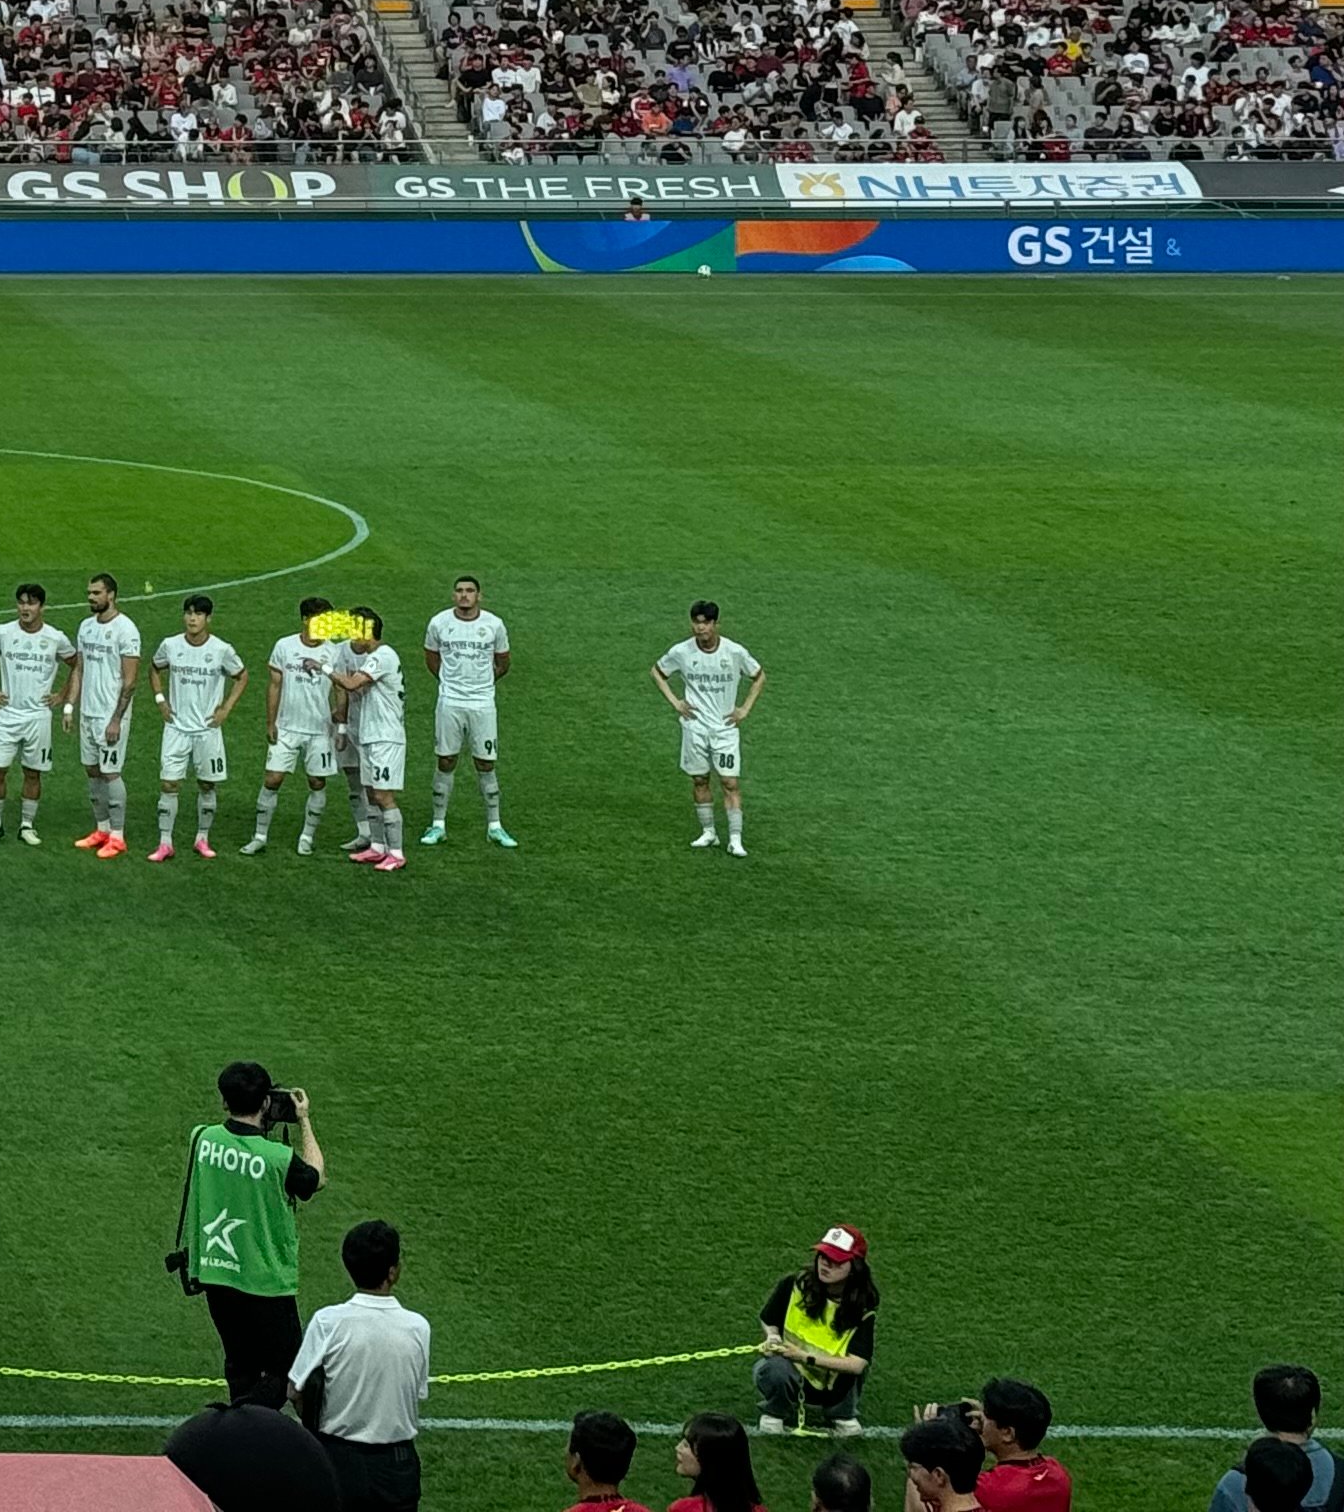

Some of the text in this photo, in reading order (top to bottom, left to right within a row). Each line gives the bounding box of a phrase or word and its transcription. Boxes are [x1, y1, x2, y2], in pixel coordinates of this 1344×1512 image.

[6, 170, 337, 206] GS SHOP
[395, 176, 762, 199] GS THE FRESH
[858, 172, 1188, 200] NH투자증권
[1007, 224, 1074, 266] GS
[1081, 224, 1155, 266] 건설
[101, 747, 118, 765] 74
[372, 766, 391, 784] 34
[198, 1139, 266, 1180] PHOTO
